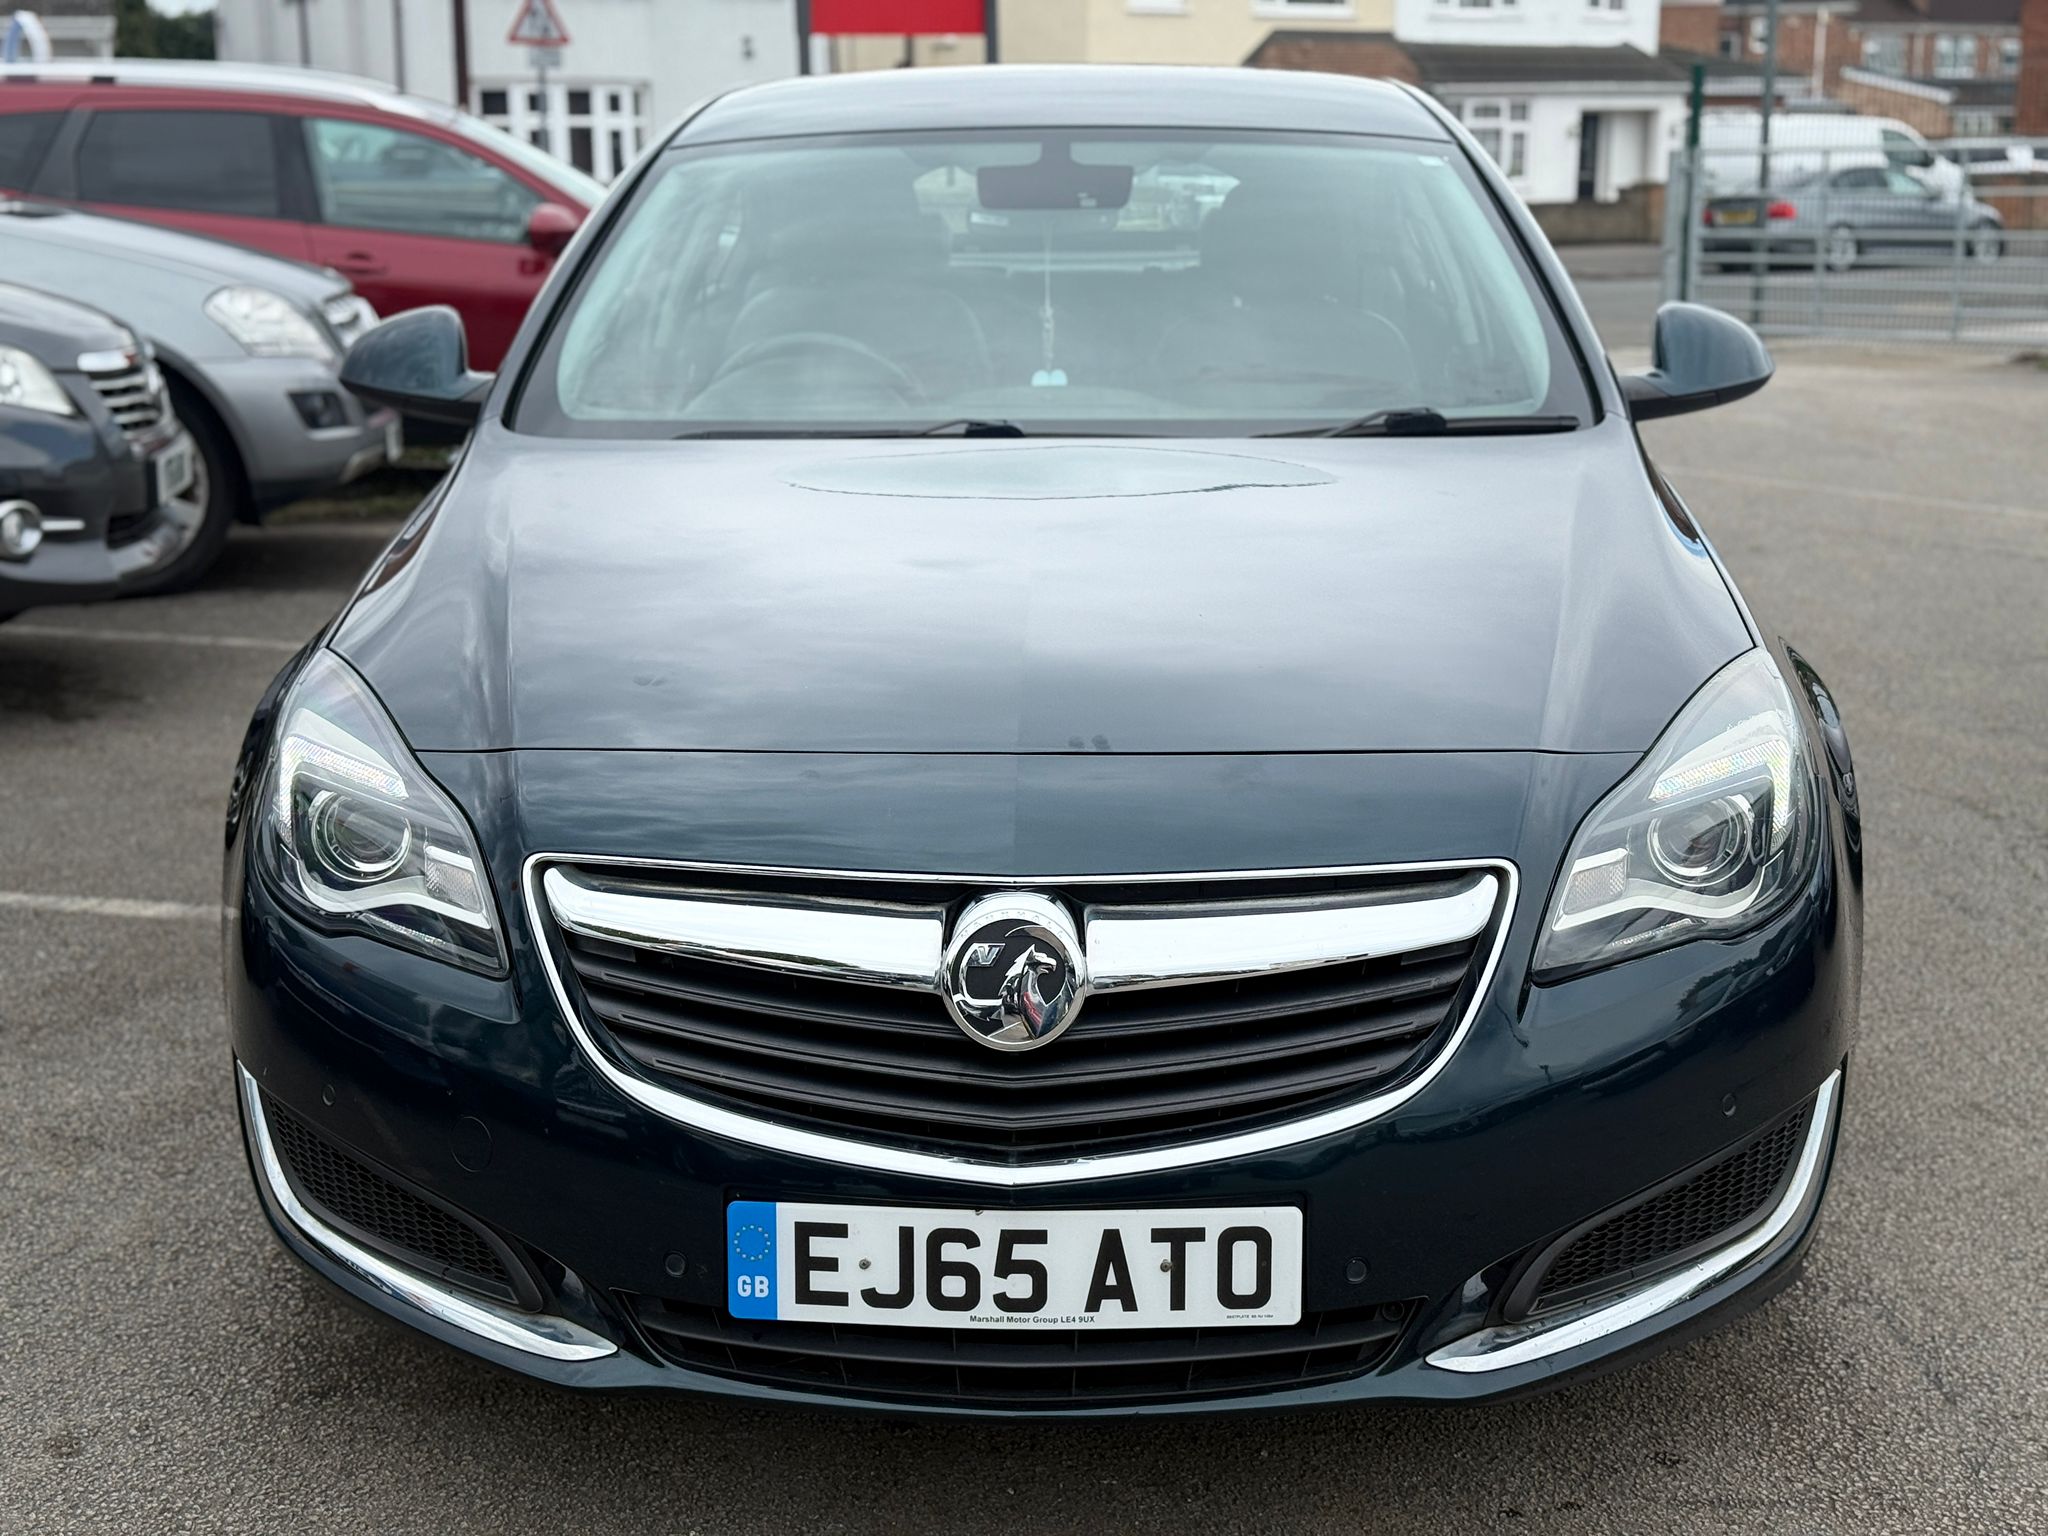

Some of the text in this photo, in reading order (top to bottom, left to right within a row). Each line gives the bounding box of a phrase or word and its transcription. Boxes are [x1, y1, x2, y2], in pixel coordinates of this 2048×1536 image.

[794, 1221, 1272, 1313] EJ65 ATO
[737, 1275, 769, 1298] GB
[969, 1315, 1005, 1323] Marshall
[1032, 1316, 1059, 1324] Group
[1078, 1315, 1096, 1323] 9UX
